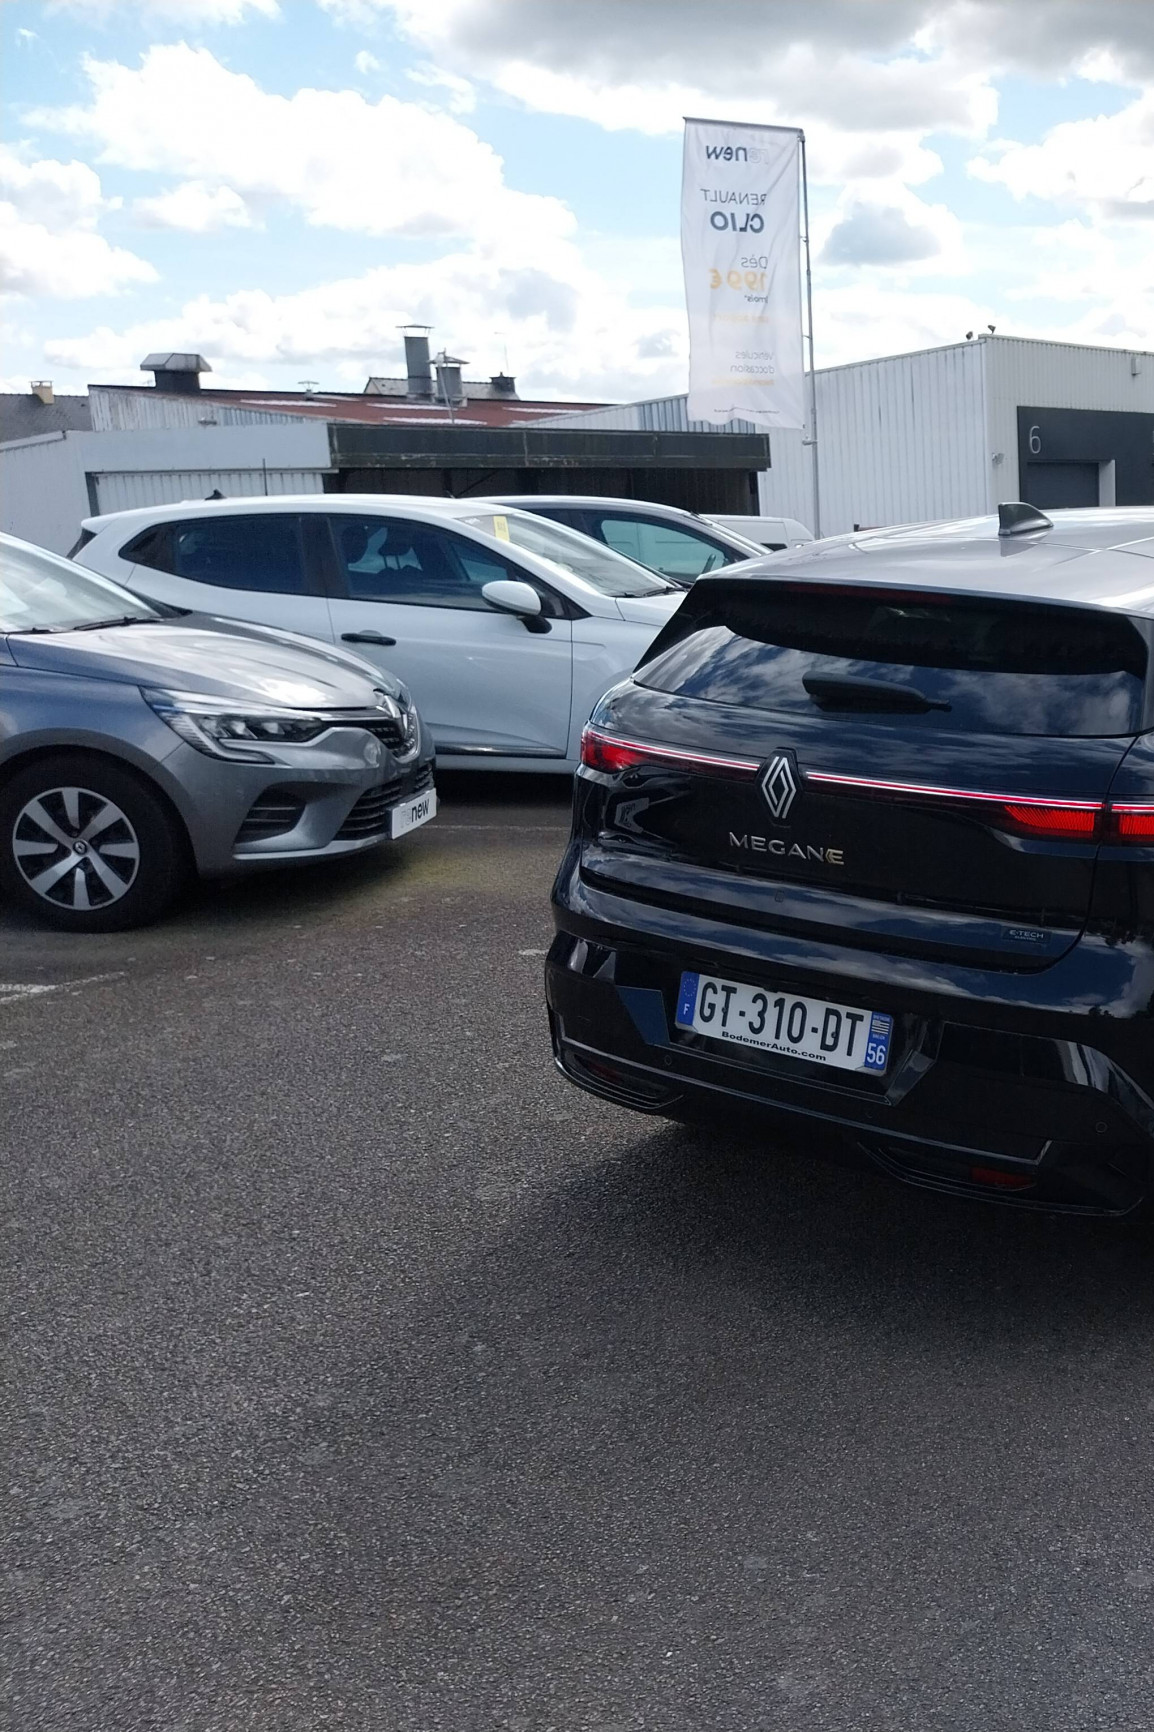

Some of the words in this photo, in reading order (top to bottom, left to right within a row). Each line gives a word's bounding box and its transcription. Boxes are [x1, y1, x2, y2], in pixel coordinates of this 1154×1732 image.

[1029, 425, 1042, 454] 6
[729, 831, 845, 866] MEGANE
[683, 1003, 690, 1016] F
[699, 981, 864, 1057] GT-310-DT
[722, 1031, 827, 1062] BodemerAuto.com
[866, 1042, 886, 1066] 56
